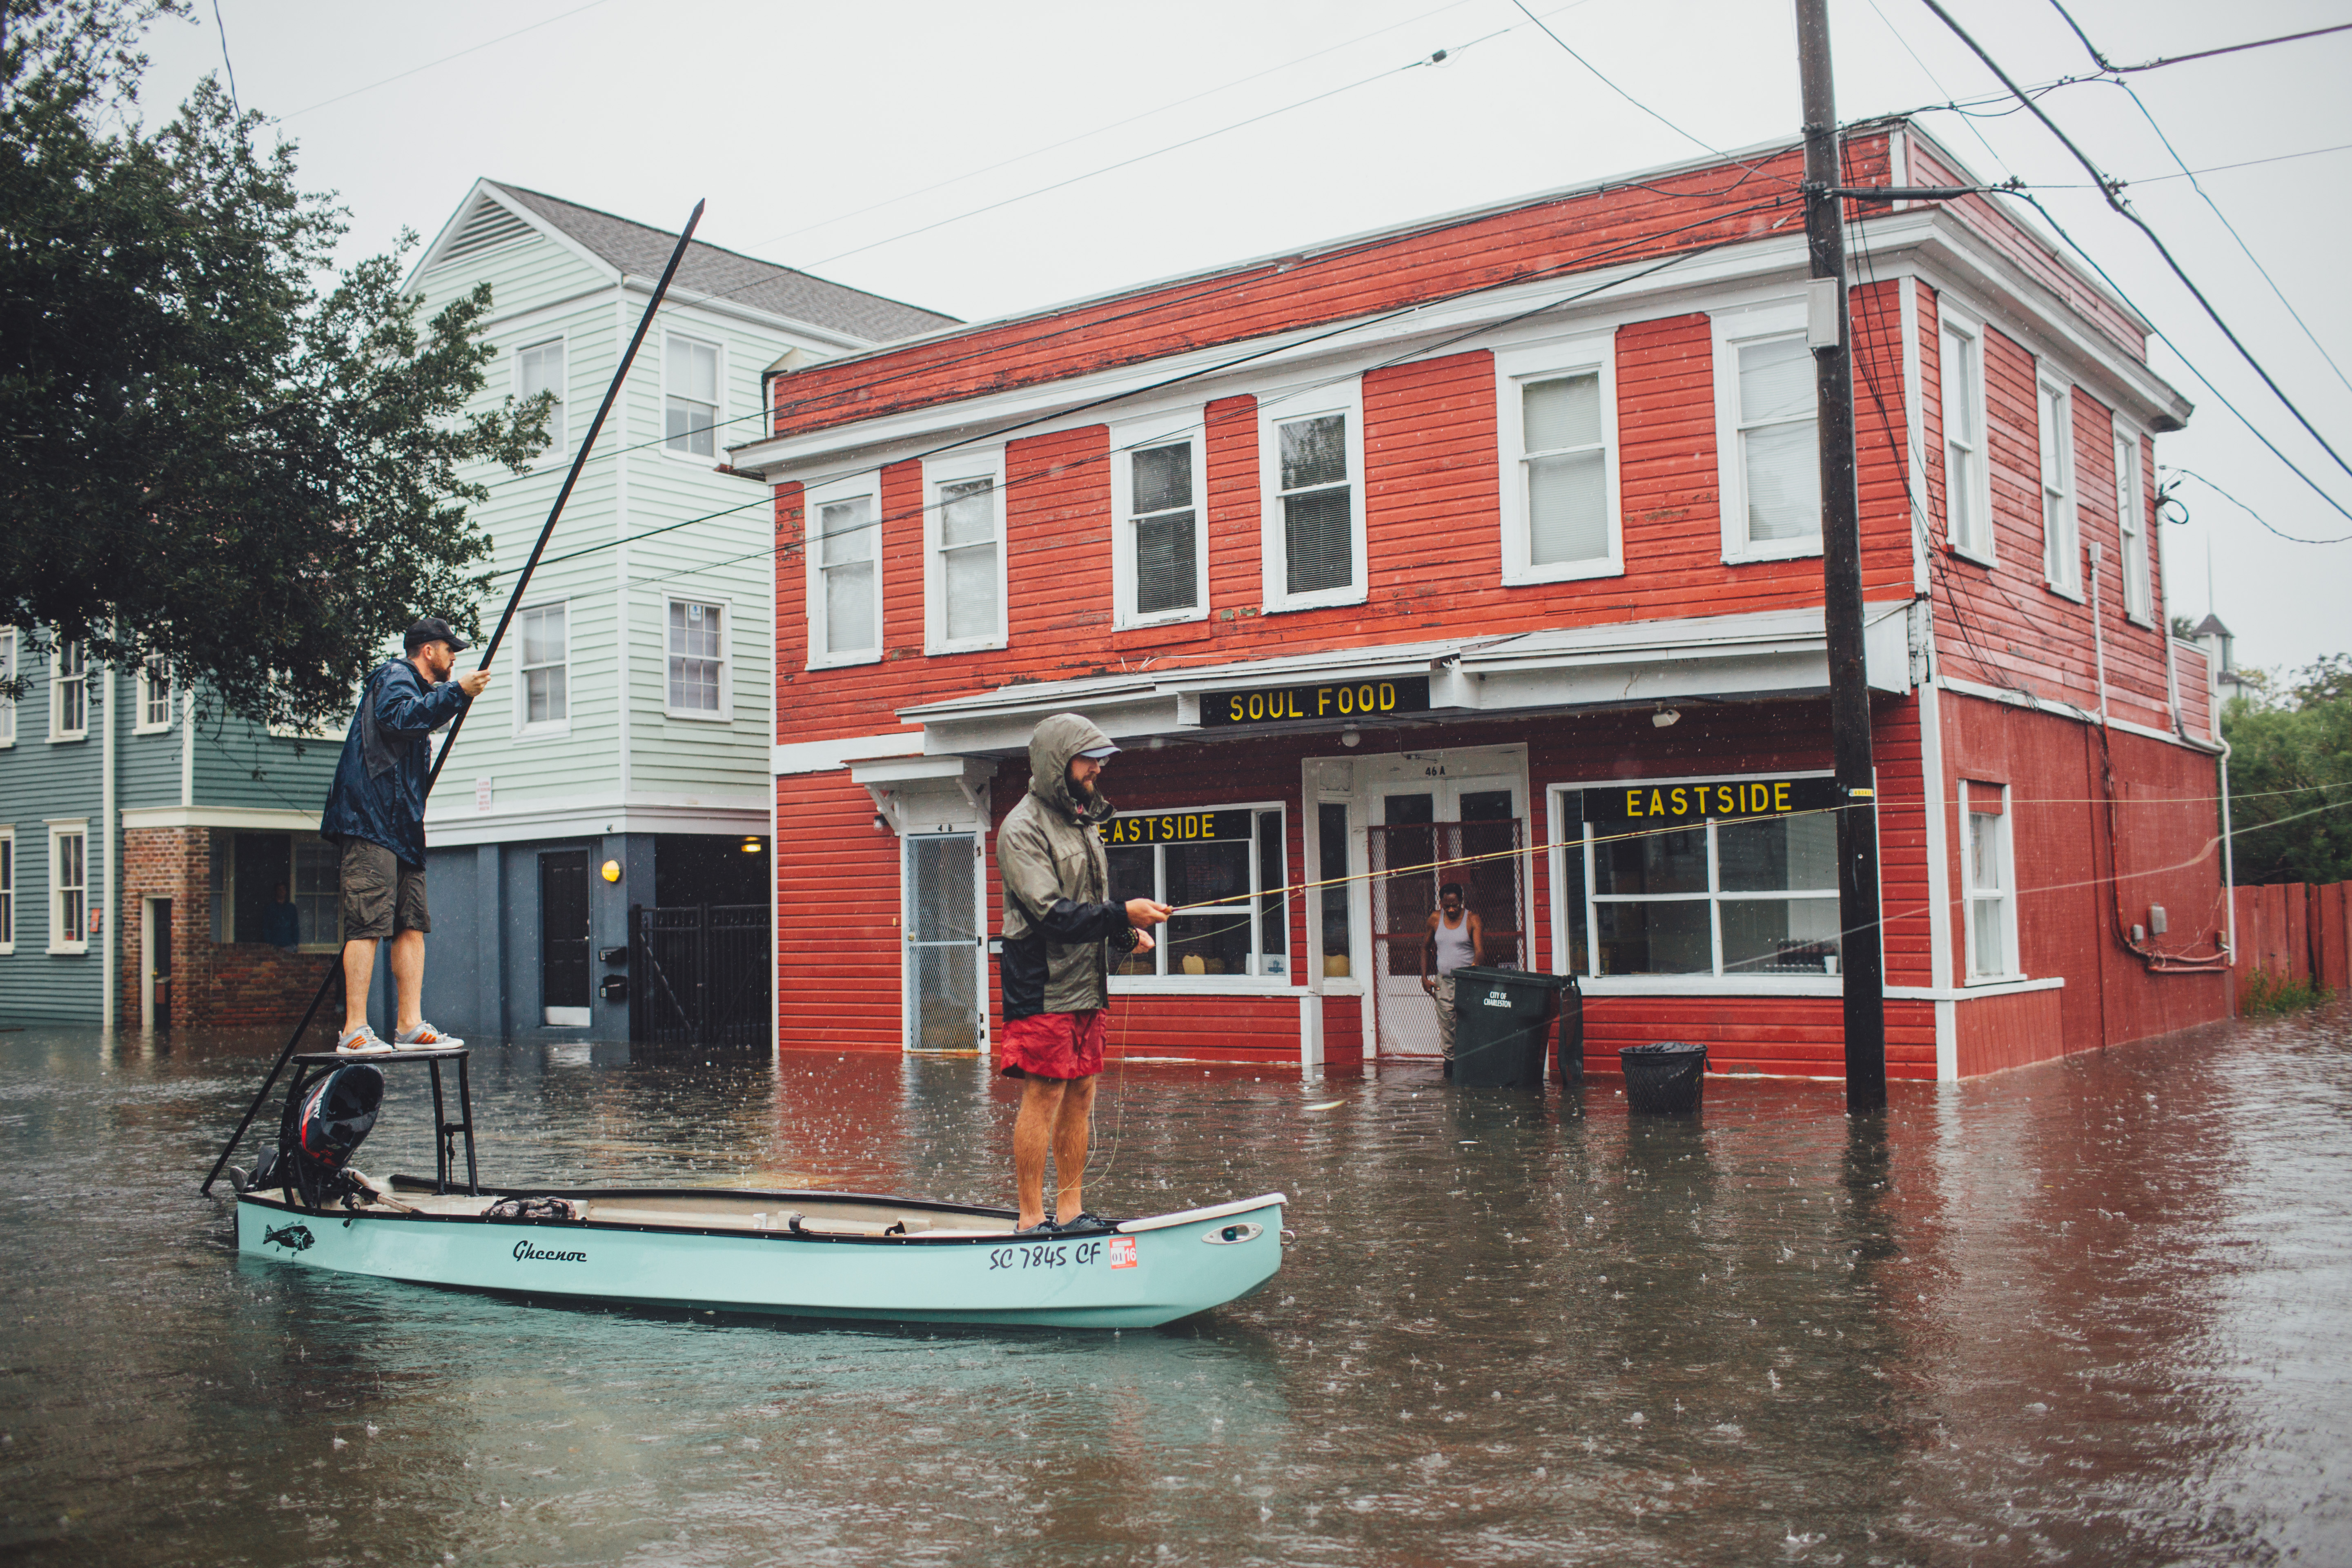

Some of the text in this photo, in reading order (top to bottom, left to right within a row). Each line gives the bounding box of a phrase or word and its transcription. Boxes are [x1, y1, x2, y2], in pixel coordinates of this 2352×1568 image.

[1230, 683, 1395, 721] SOUL FOOD
[1425, 765, 1446, 776] 46 A
[1627, 782, 1792, 816] EASTSIDE
[948, 824, 952, 832] B
[1097, 814, 1215, 842] EASTSIDE
[1483, 998, 1512, 1008] CHARLESTON
[513, 1240, 587, 1262] Gheenoe
[989, 1242, 1101, 1270] SC 7845 CF
[1112, 1247, 1137, 1262] 01 16
